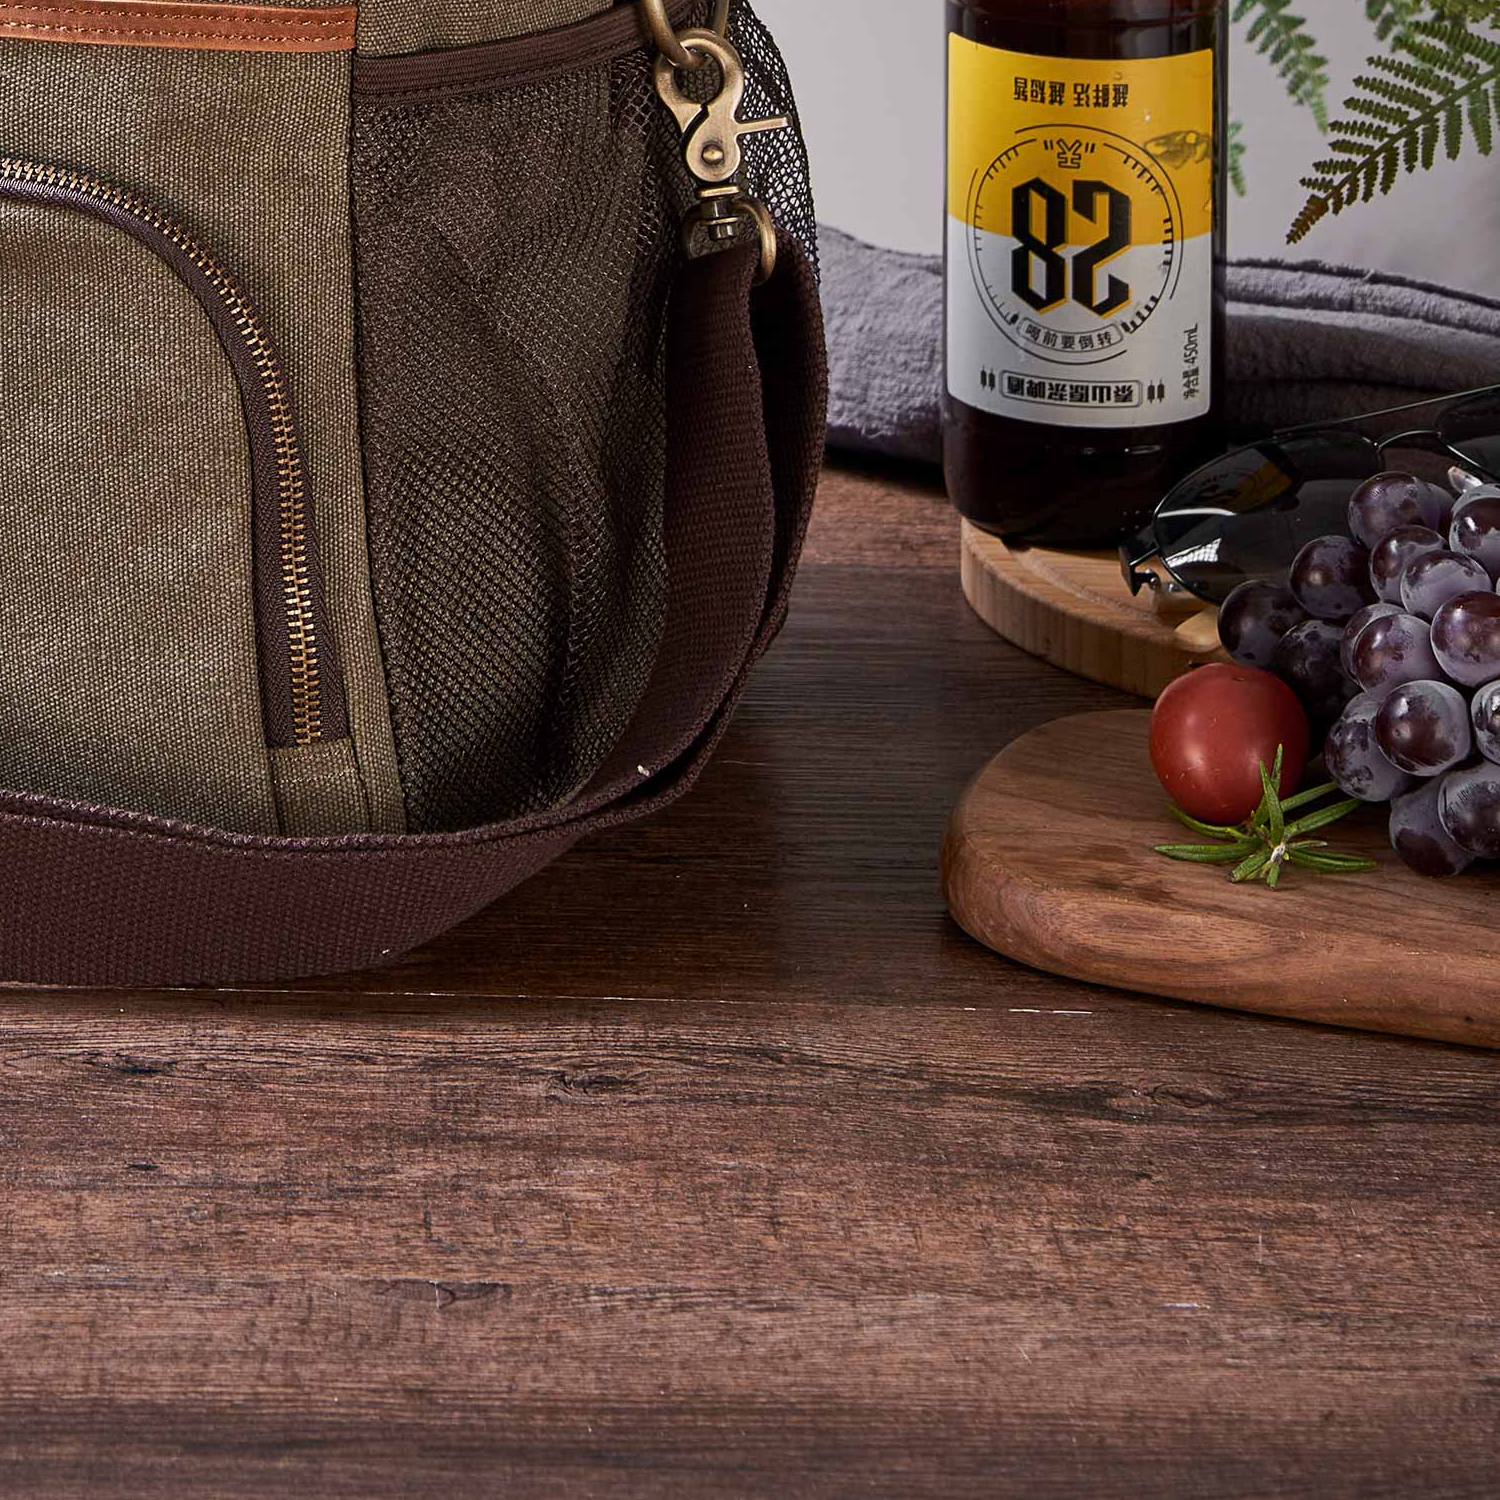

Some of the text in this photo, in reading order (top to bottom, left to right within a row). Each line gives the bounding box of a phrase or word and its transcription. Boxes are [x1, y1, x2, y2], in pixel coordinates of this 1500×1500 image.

[1073, 83, 1129, 108] 越鲜活
[1025, 323, 1112, 350] 喝前要倒转
[1006, 375, 1134, 403] 泰山原浆啤酒
